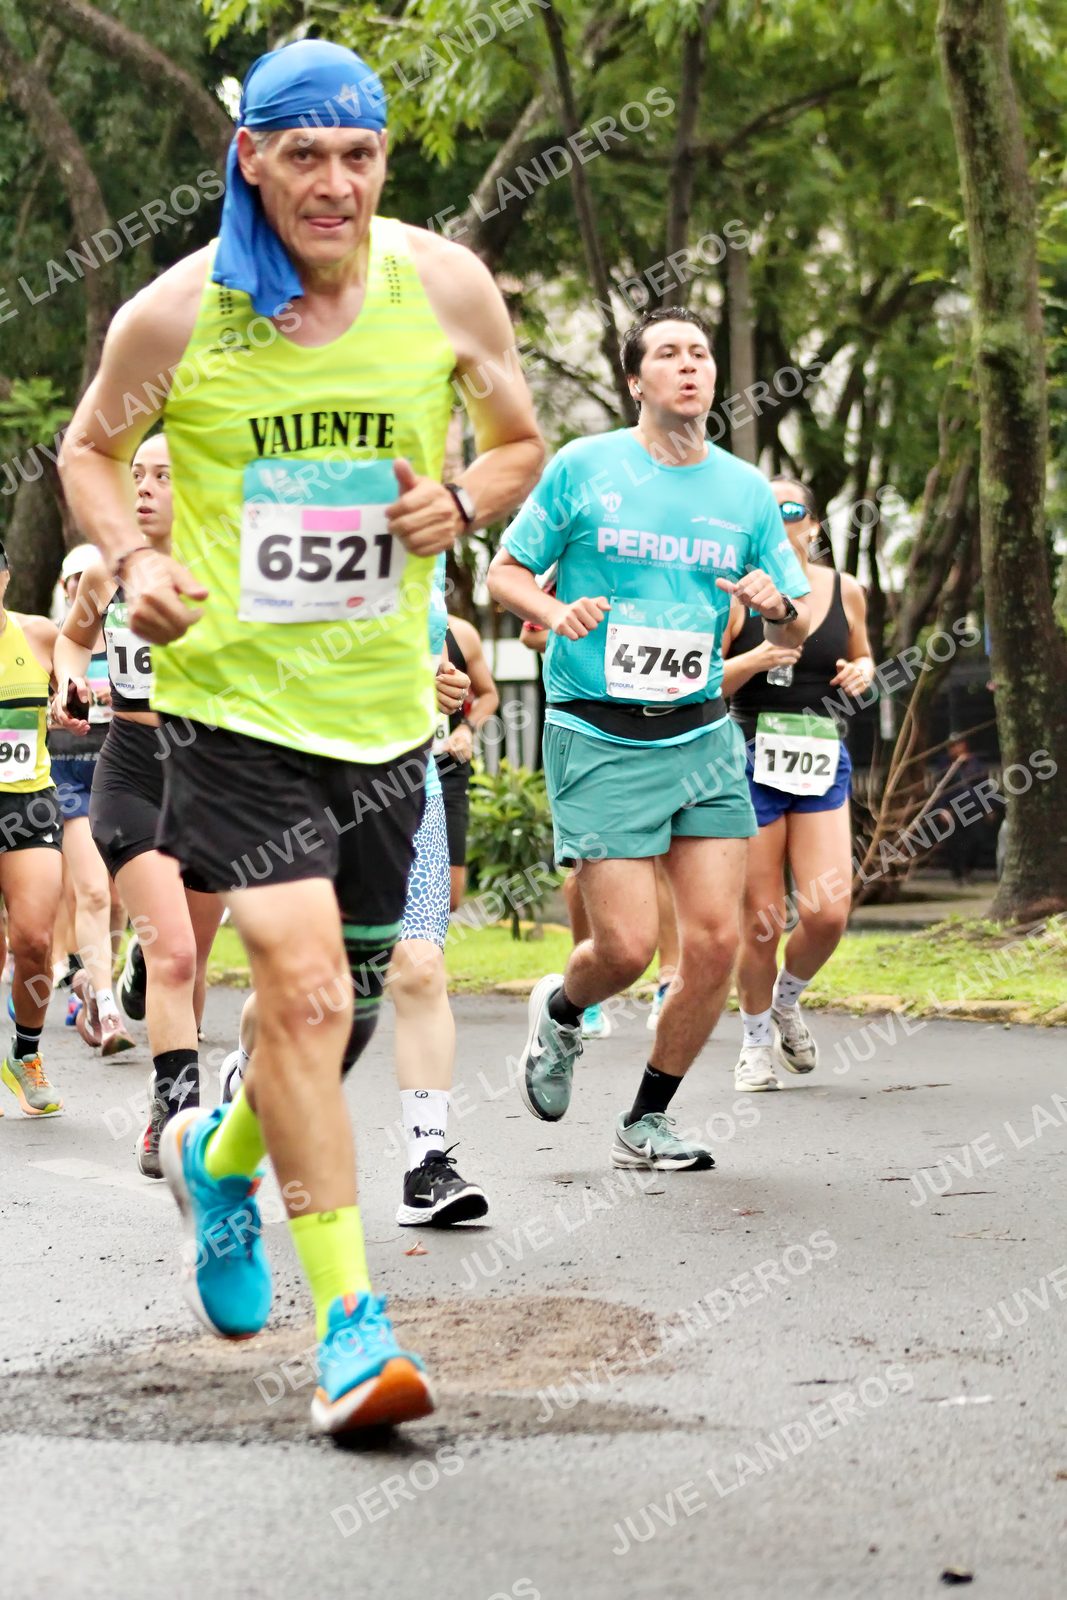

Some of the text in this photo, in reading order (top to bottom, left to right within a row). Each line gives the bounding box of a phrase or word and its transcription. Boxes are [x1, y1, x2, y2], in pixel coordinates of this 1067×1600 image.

[249, 411, 395, 456] VALENTE
[257, 534, 393, 582] 6521
[597, 527, 738, 571] PERDURA
[611, 643, 703, 679] 4746
[764, 748, 831, 776] 1702
